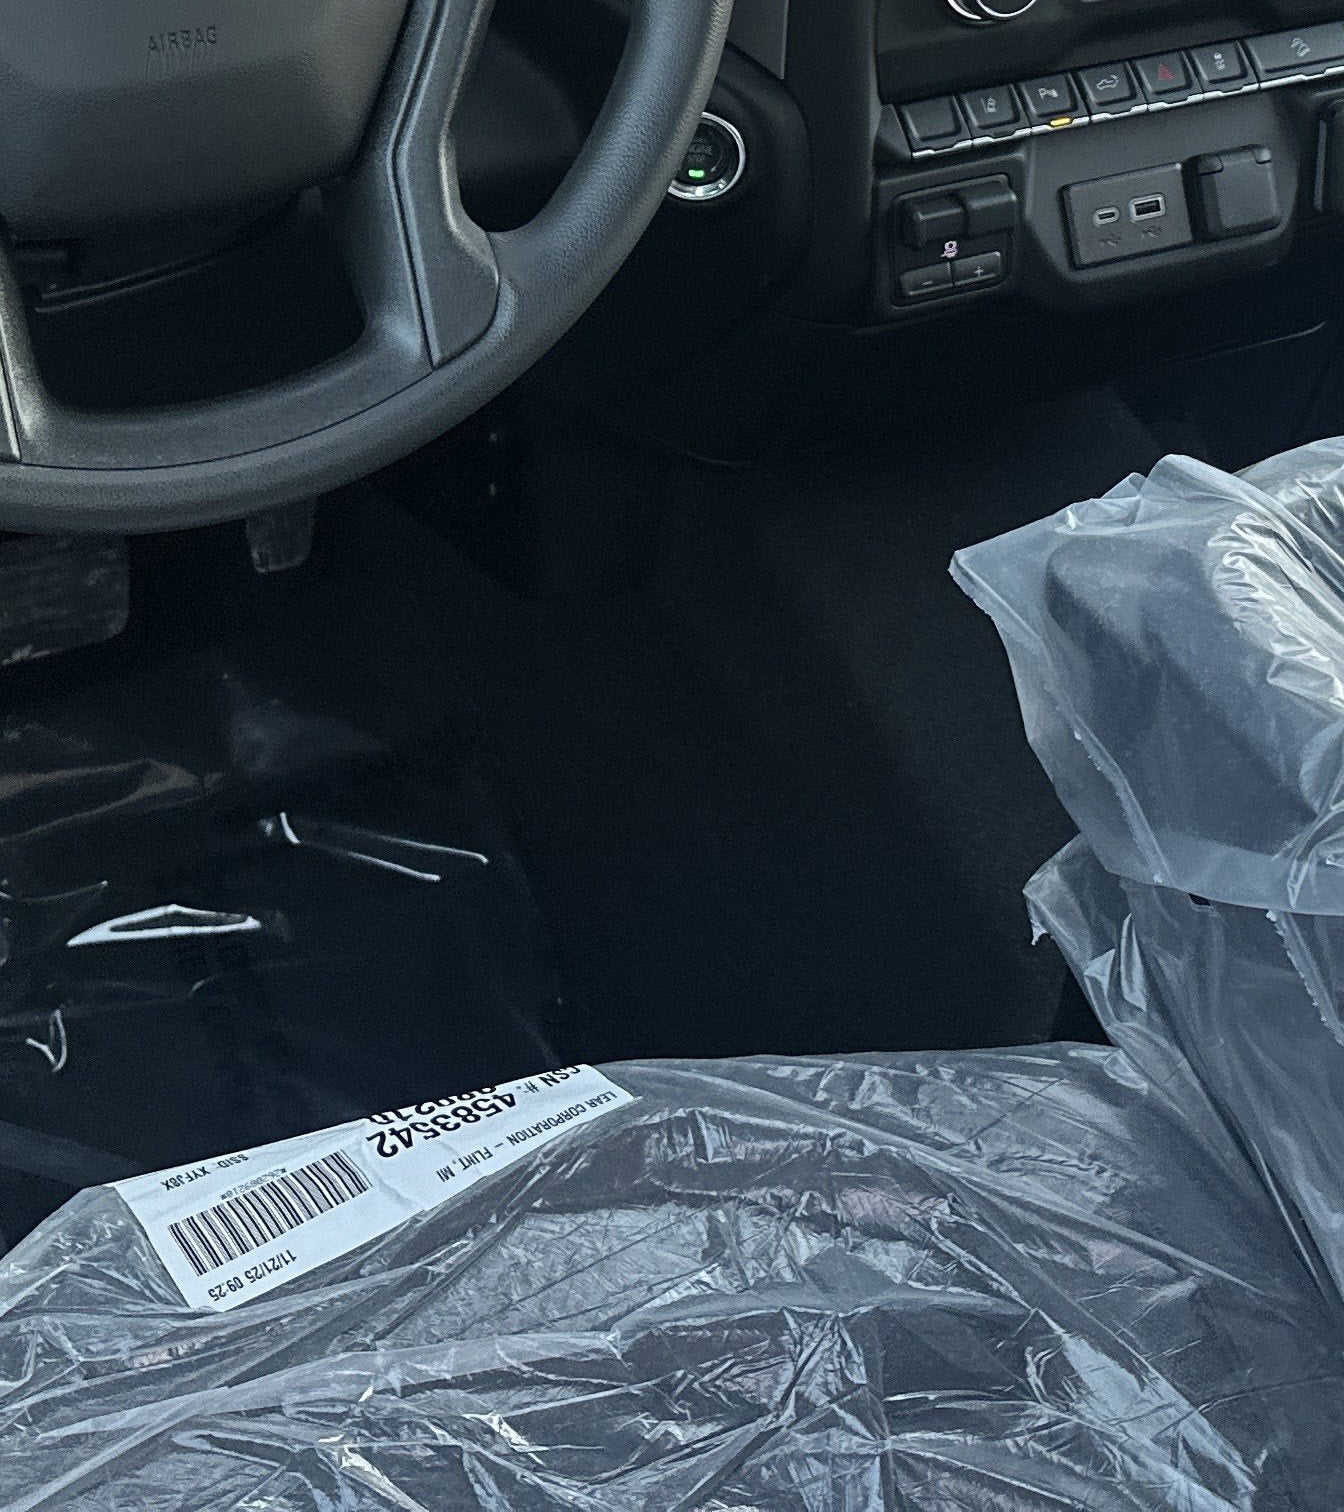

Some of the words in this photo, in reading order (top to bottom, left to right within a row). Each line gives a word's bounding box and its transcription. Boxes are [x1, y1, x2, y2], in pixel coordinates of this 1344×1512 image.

[148, 26, 217, 51] AIRBAG
[586, 1091, 618, 1108] LEAR
[366, 1092, 517, 1158] 4583542
[506, 1103, 588, 1146] CORPORATION
[160, 1166, 211, 1191] XYFJ8X
[435, 1165, 456, 1183] MI
[244, 1249, 297, 1284] 11/21/25
[208, 1276, 244, 1302] 09:25
